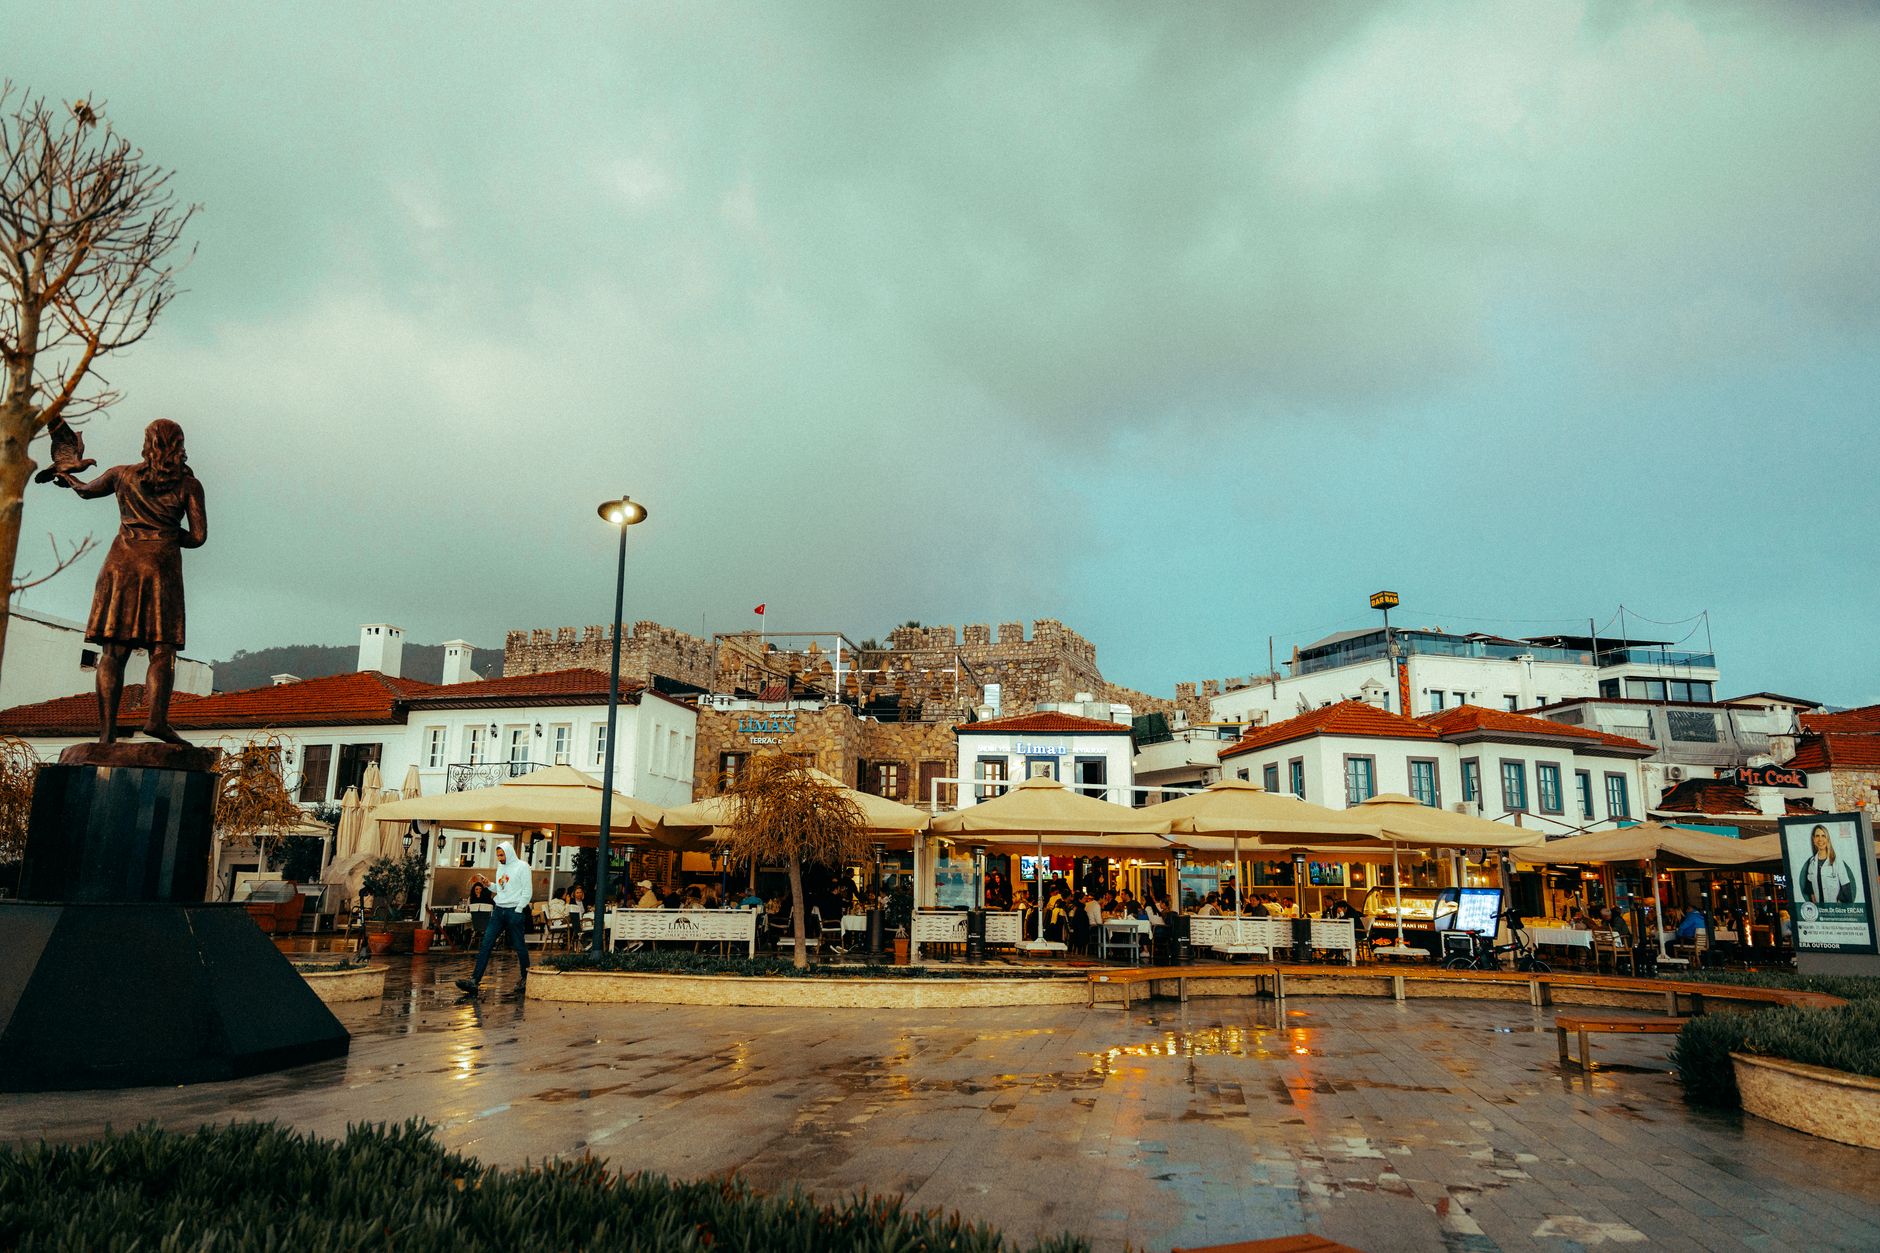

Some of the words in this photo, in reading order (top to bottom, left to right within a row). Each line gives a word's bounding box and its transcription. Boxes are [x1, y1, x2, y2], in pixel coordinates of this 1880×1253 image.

[1371, 597, 1384, 607] BAR
[1385, 595, 1398, 603] BAR
[1015, 741, 1067, 755] Liman
[1739, 767, 1763, 785] Mr.
[1765, 769, 1805, 787] Cook
